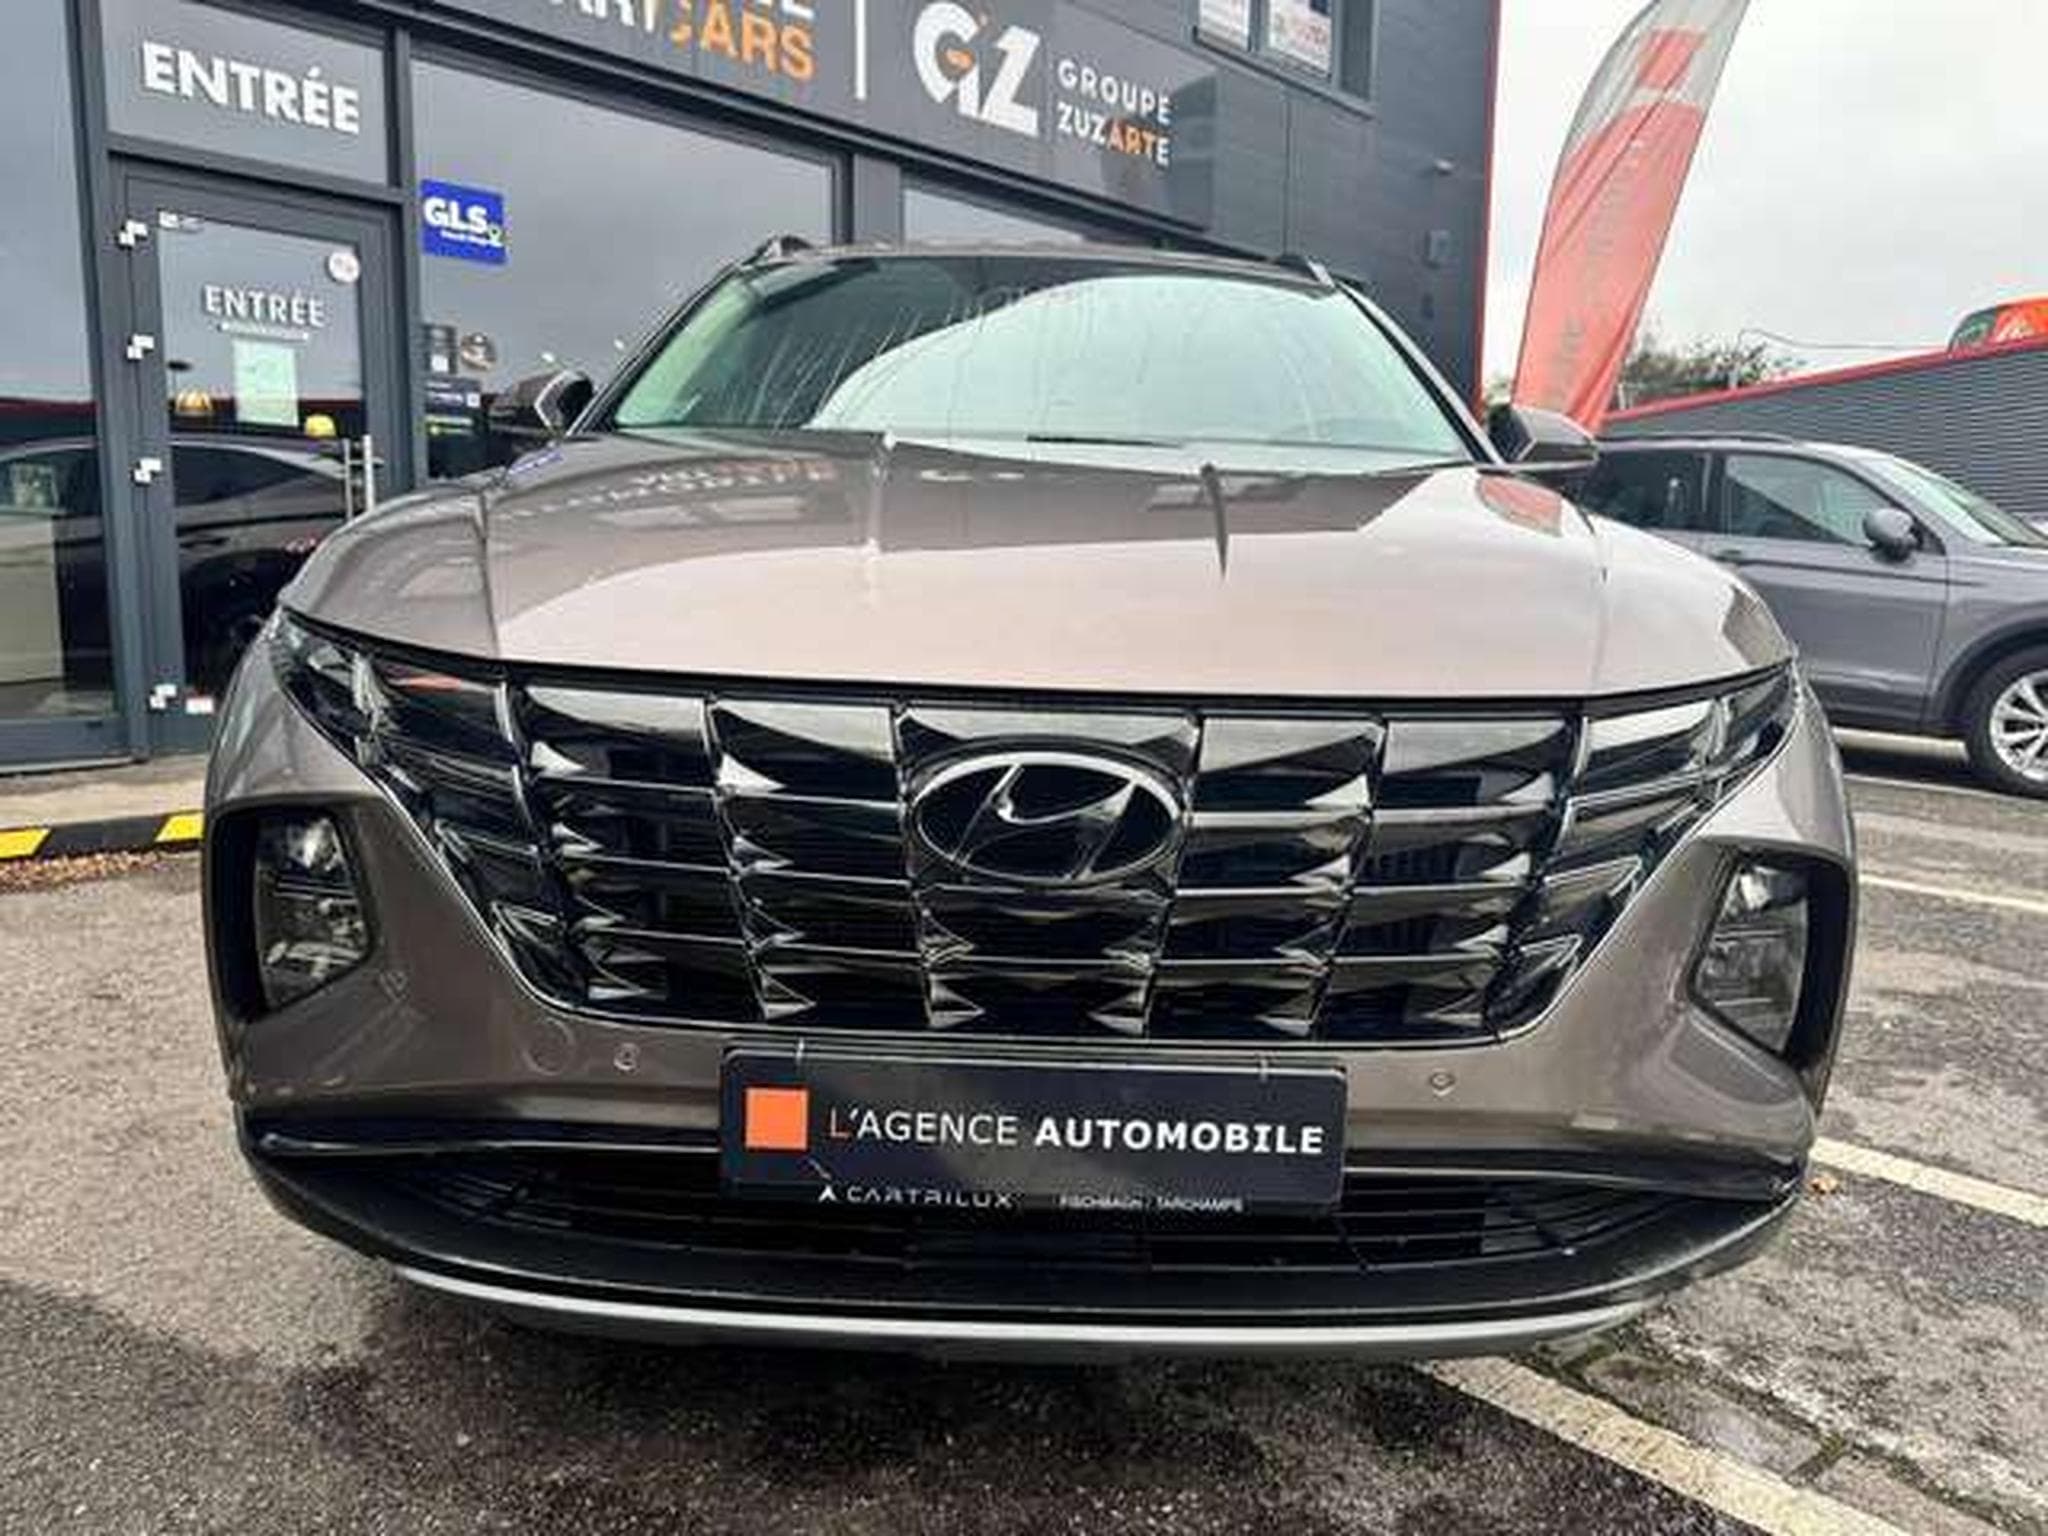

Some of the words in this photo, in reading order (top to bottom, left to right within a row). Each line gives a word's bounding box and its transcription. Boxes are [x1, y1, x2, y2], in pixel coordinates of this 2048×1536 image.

[142, 40, 360, 134] ENTRÉE
[1057, 58, 1172, 126] GROUPE
[1056, 101, 1171, 167] ZUZARTE
[424, 196, 488, 234] GLS
[204, 283, 326, 328] ENTRÉE
[828, 1108, 1019, 1146] L'AGENCE
[1033, 1116, 1326, 1156] AUTOMOBILE
